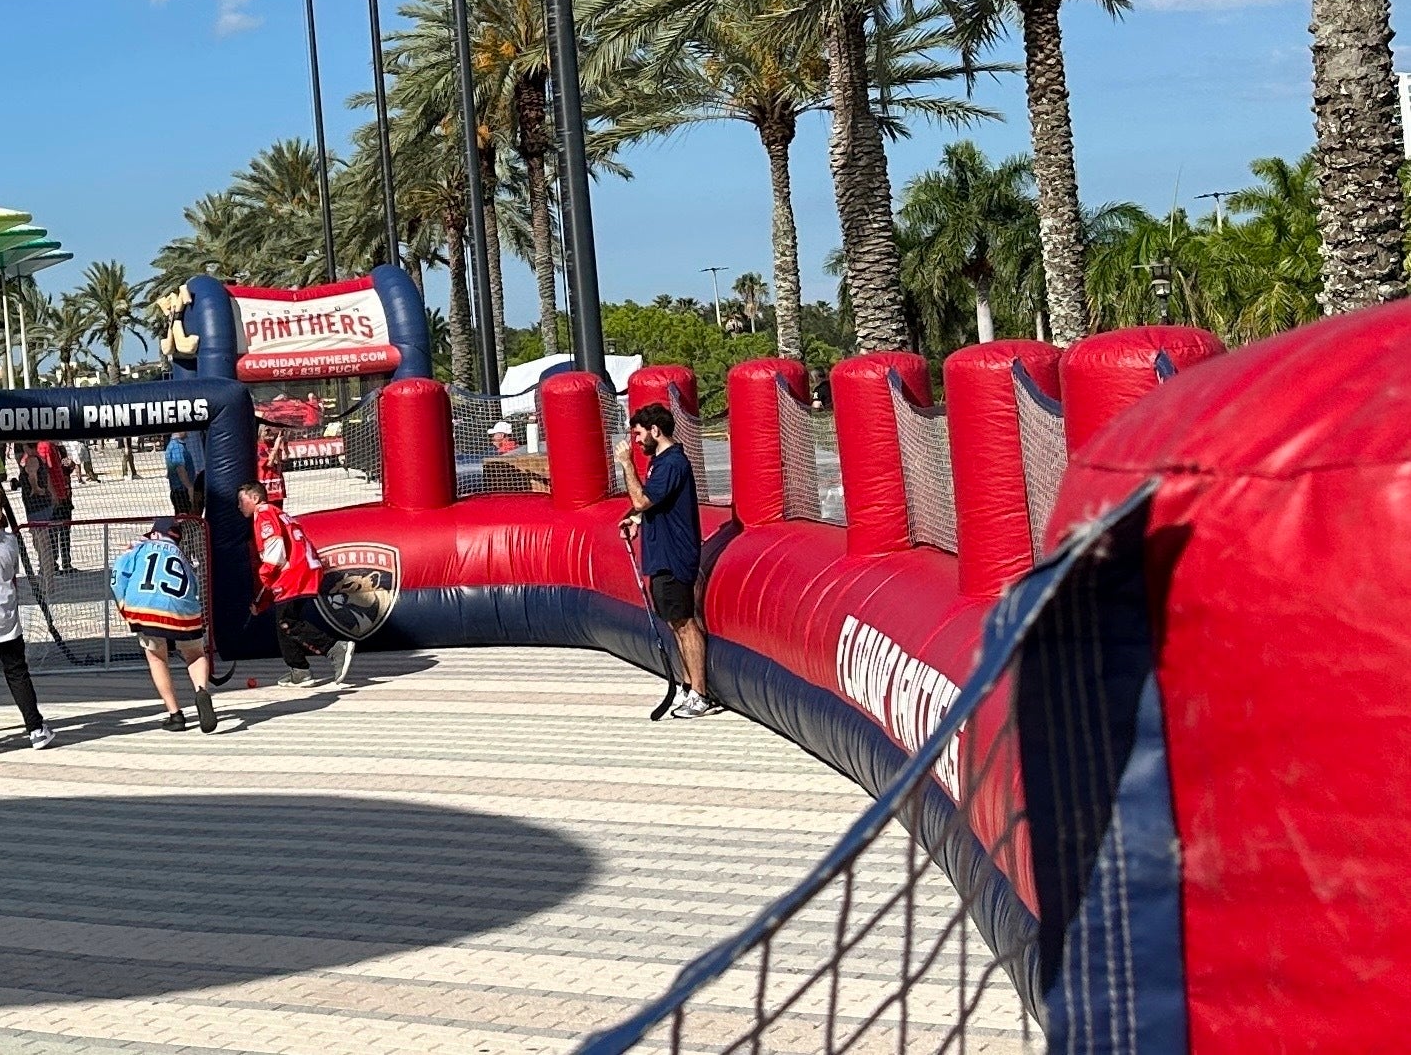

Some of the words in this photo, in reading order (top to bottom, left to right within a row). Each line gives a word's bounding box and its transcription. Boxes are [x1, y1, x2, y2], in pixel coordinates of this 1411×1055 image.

[245, 313, 375, 347] PANTHERS
[245, 351, 387, 369] FLORIDAPANTHERS.COM
[83, 398, 209, 429] PANTHERS
[321, 551, 387, 567] LORIDA
[139, 552, 189, 599] 19
